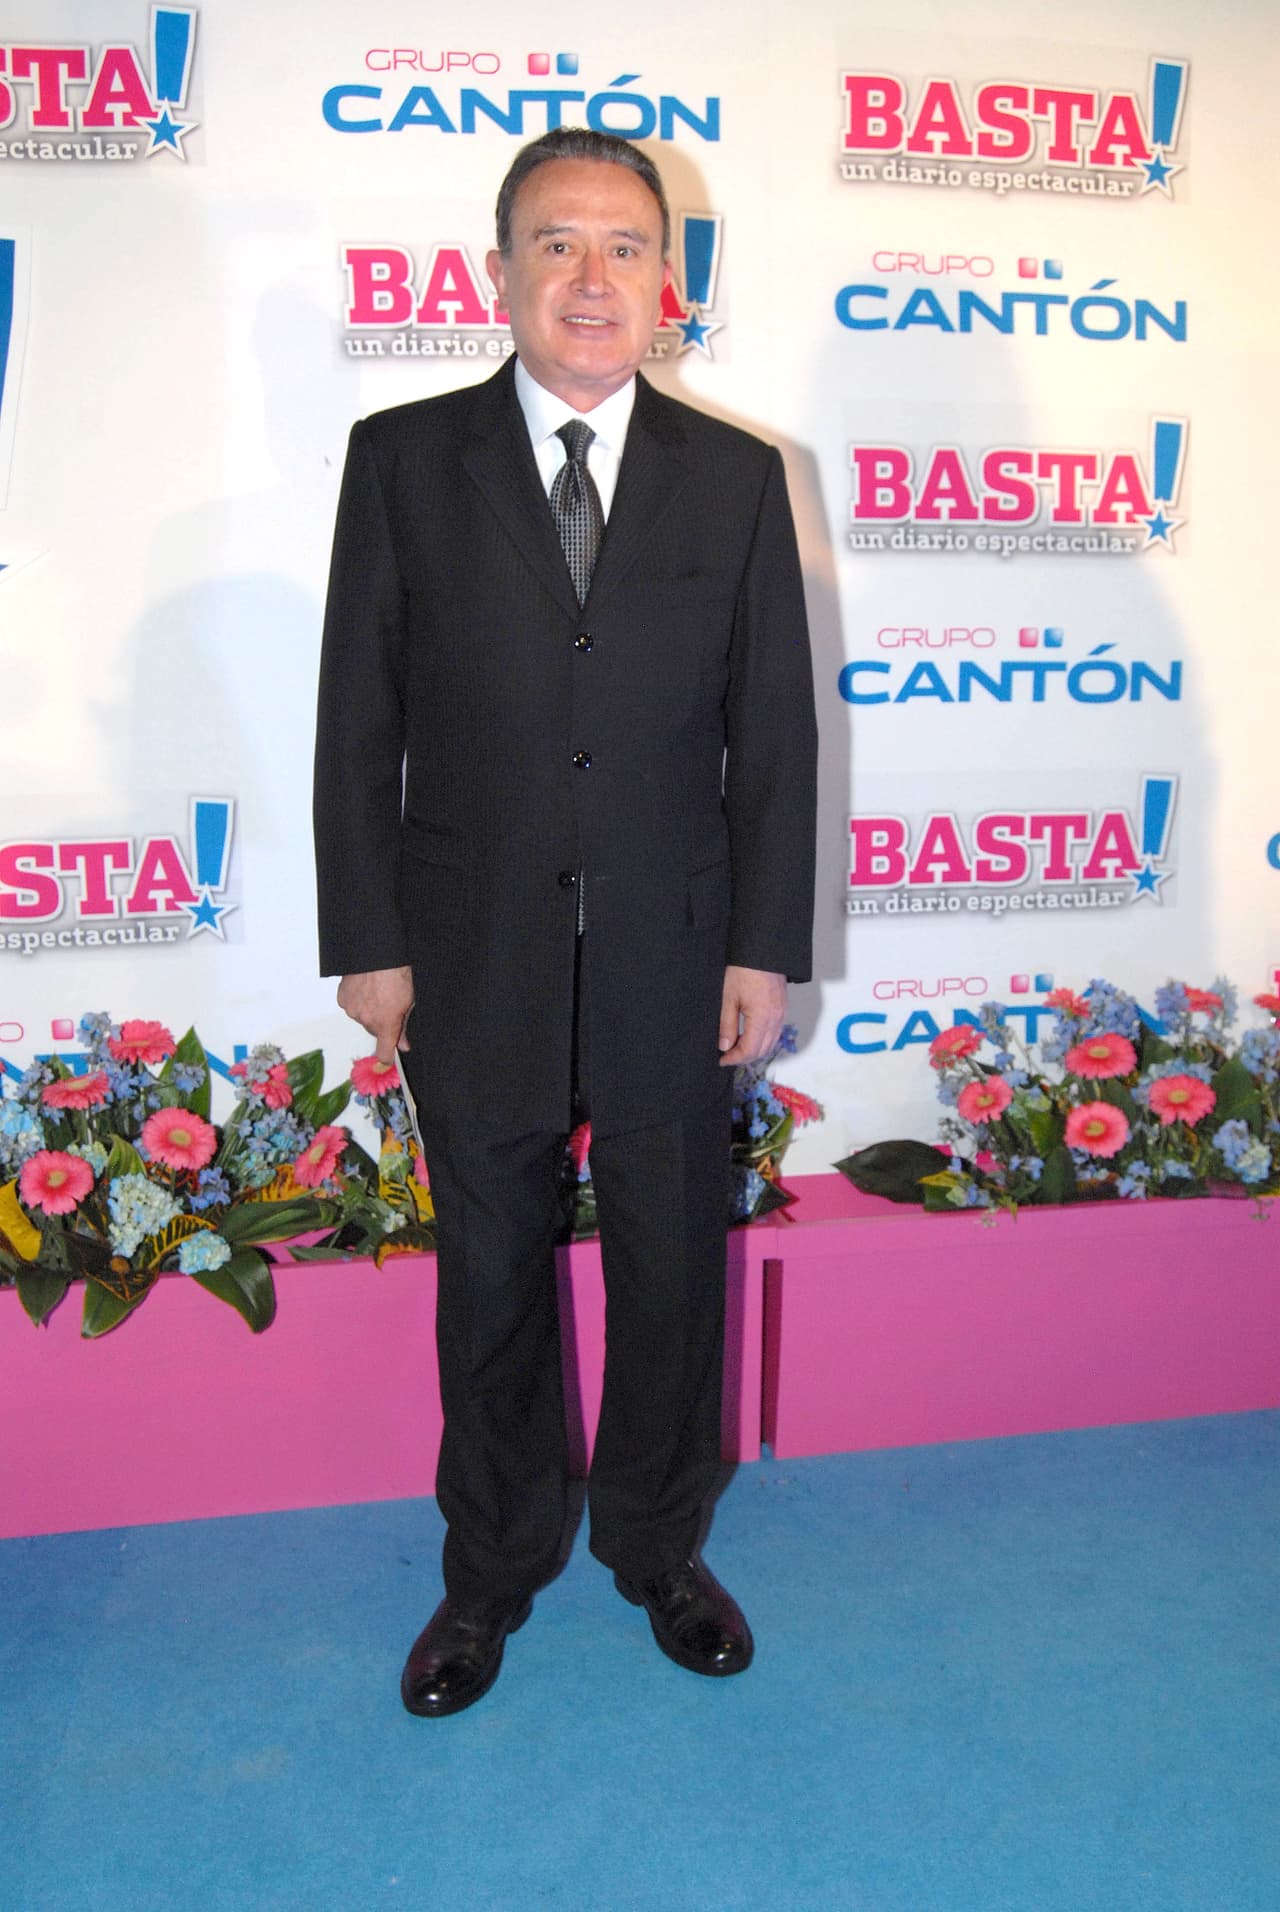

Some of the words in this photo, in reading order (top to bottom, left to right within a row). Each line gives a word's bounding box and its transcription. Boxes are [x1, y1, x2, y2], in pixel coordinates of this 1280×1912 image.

[364, 48, 501, 75] GRUPO
[321, 73, 721, 142] CANTÓN
[840, 57, 1188, 200] BASTA!
[839, 162, 876, 181] un
[883, 159, 962, 187] diario
[968, 172, 1135, 198] espectacular
[872, 251, 994, 278] GRUPO
[834, 279, 1188, 343] CANTÓN
[344, 335, 385, 357] un
[391, 331, 479, 357] diario
[848, 415, 1188, 553] BASTA!
[849, 531, 885, 549] un
[891, 529, 969, 551] diario
[974, 533, 1136, 555] espectacular
[877, 627, 996, 648] GRUPO
[837, 643, 1183, 705] CANTÓN
[848, 775, 1177, 905] BASTA!
[847, 900, 878, 915] un
[885, 893, 960, 914] diario
[966, 887, 1125, 915] espectacular
[873, 976, 988, 999] GRUPO
